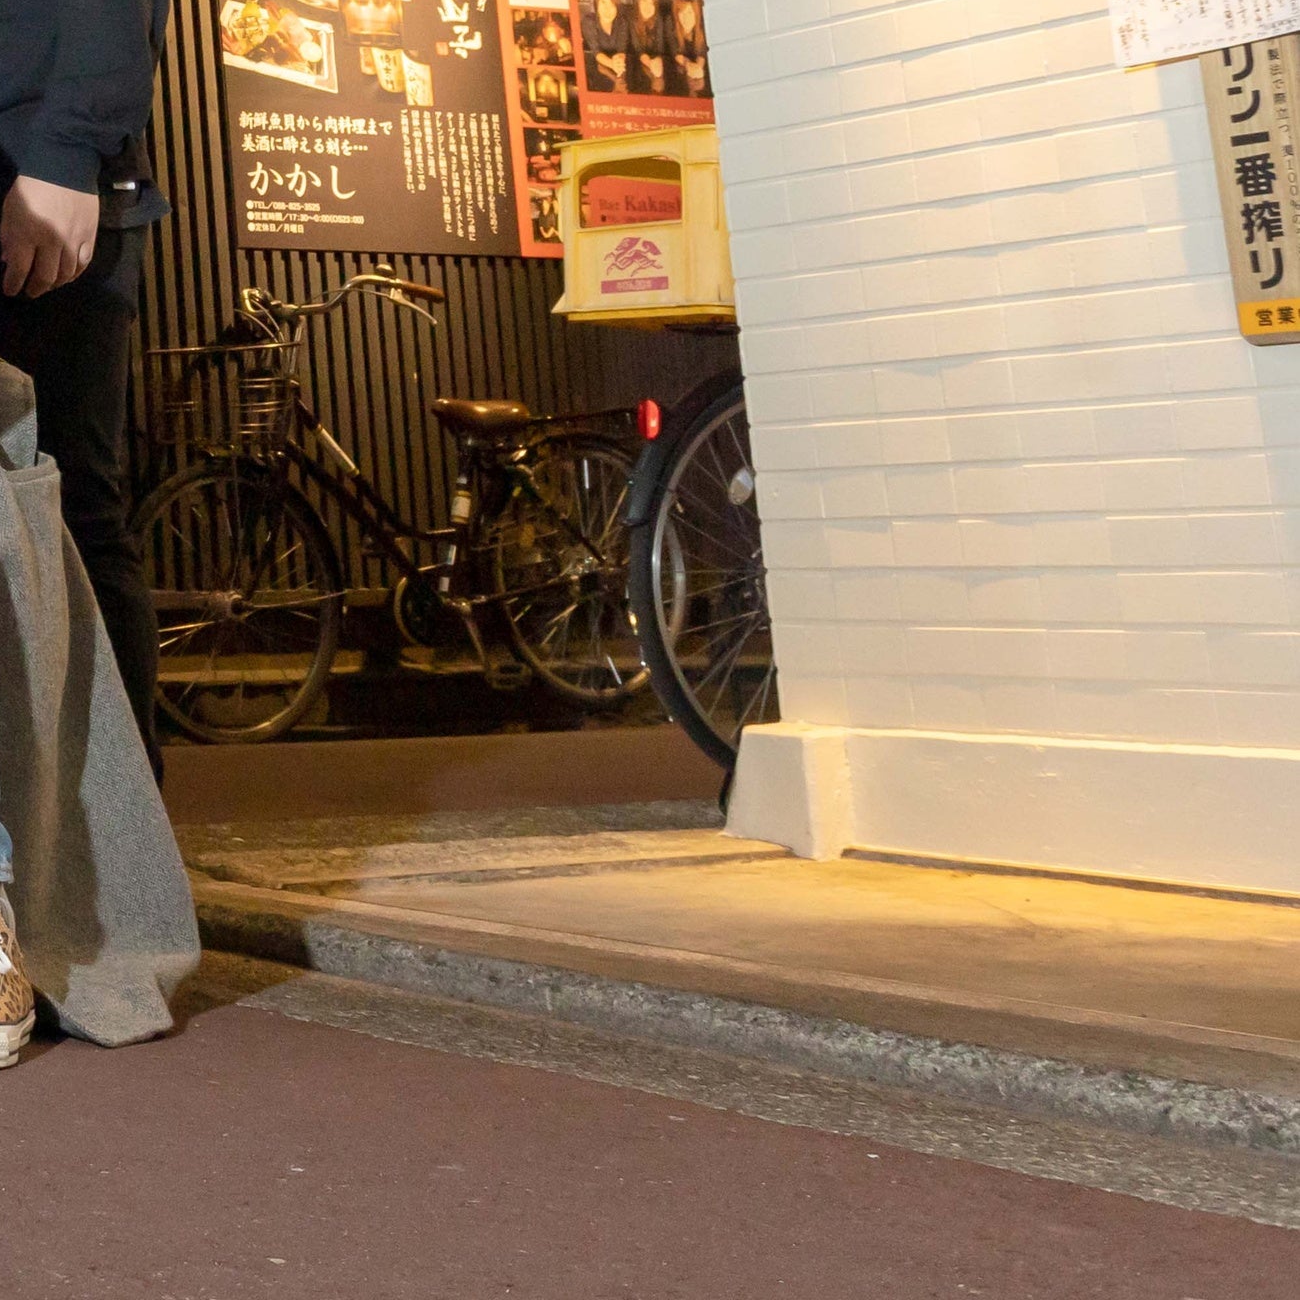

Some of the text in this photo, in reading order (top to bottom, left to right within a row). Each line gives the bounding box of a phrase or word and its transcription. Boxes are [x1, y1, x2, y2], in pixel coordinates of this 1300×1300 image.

[239, 111, 393, 135] 新鮮魚貝から肉料理まで
[247, 161, 357, 200] かかし
[1255, 305, 1300, 327] 営業
